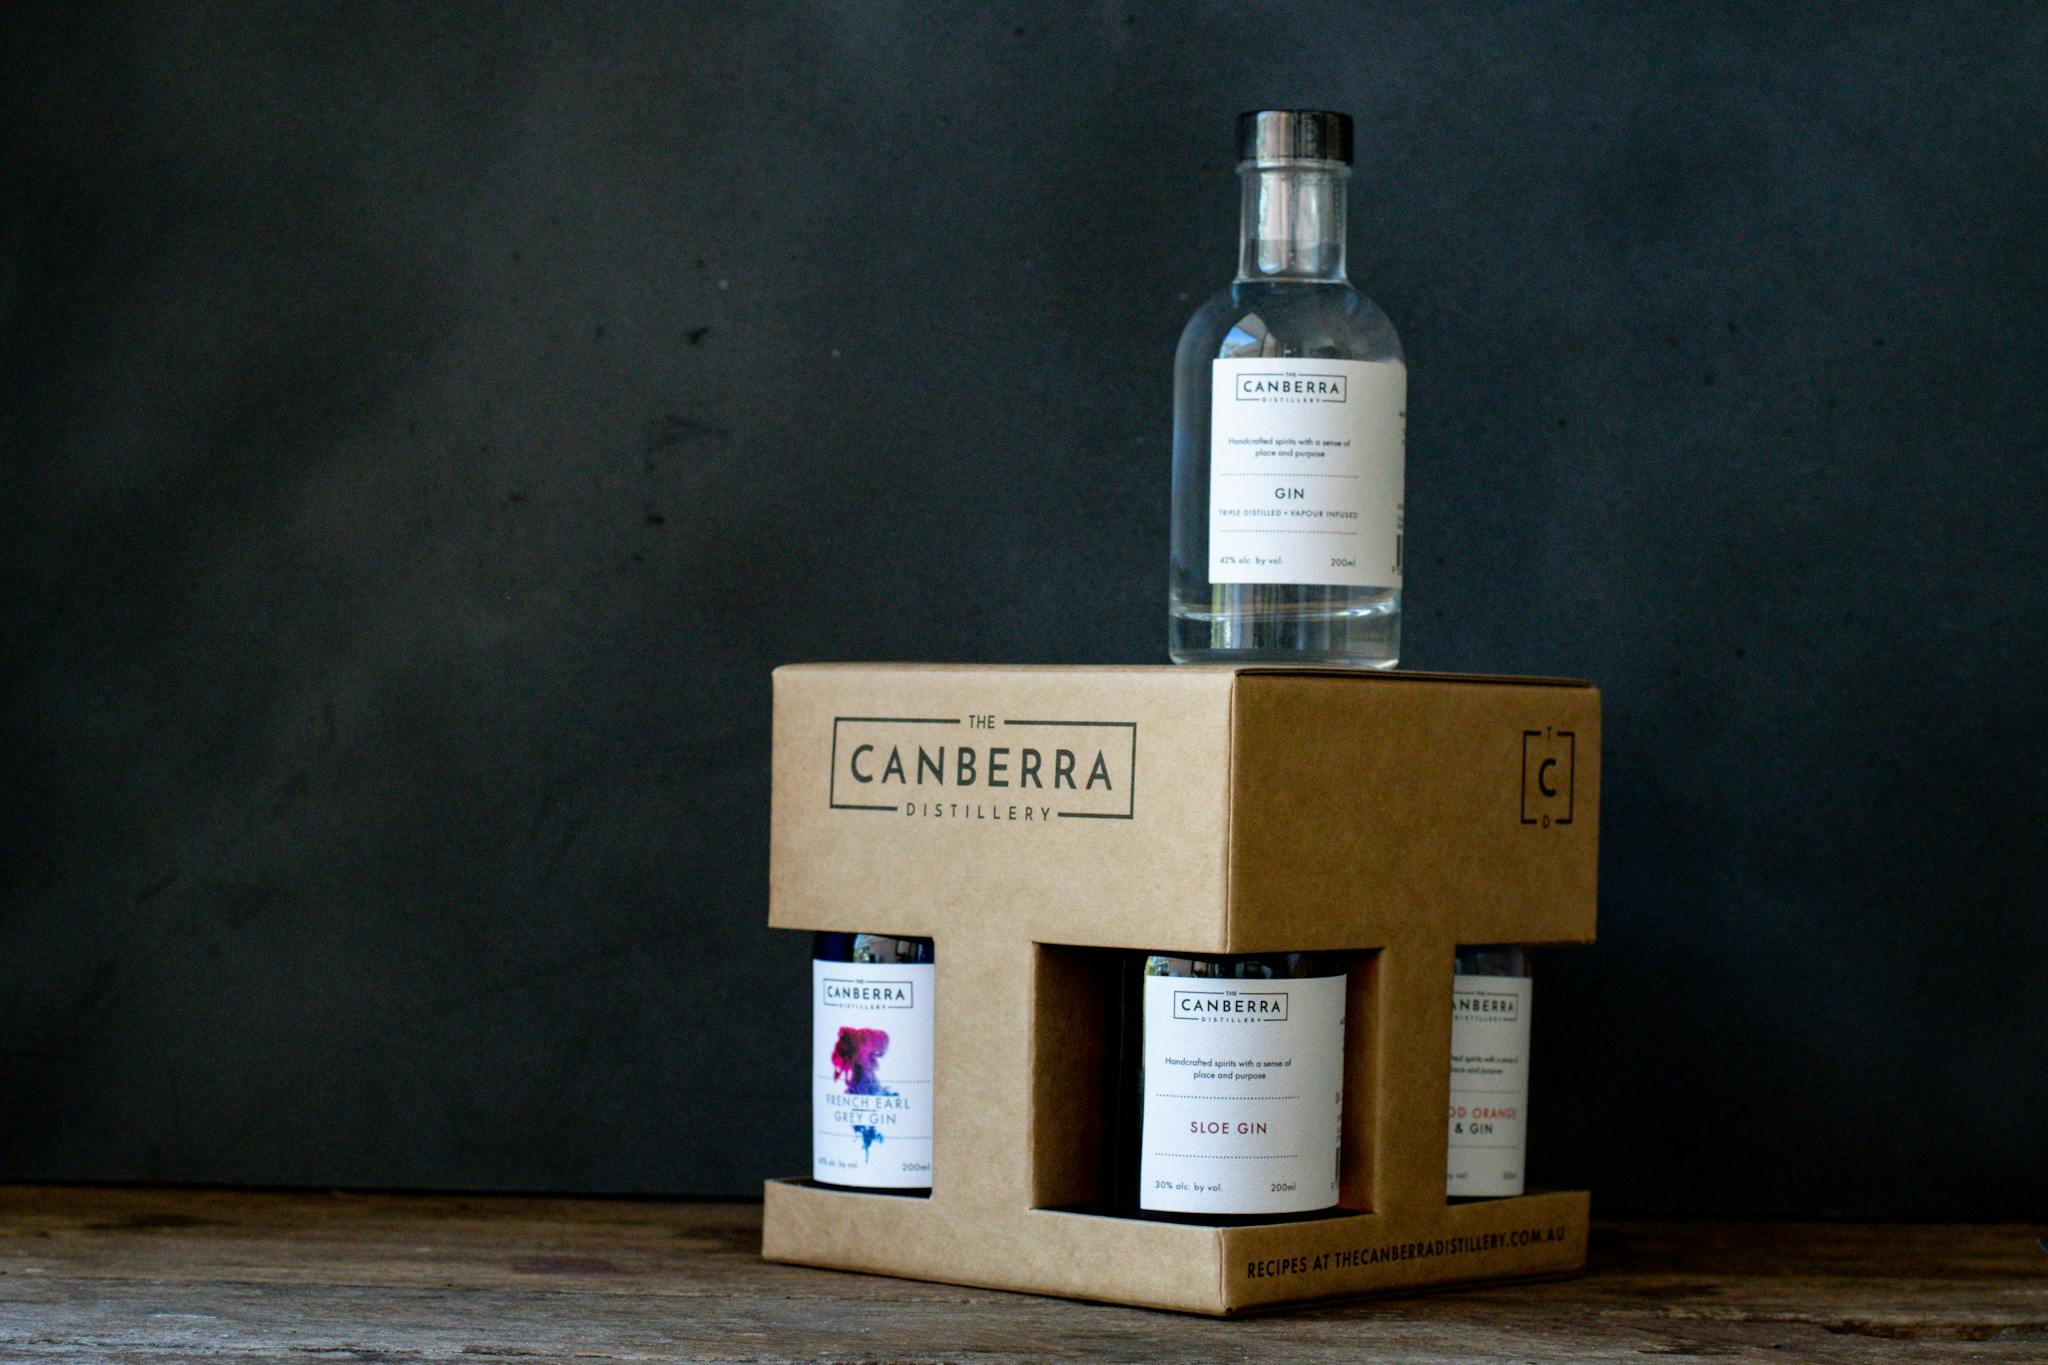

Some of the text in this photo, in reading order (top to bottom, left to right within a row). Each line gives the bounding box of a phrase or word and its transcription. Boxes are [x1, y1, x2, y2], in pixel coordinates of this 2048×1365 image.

[1243, 380, 1340, 394] CANBERRA
[1229, 438, 1273, 446] Handcrafted
[1275, 438, 1296, 447] spirits
[1298, 438, 1314, 446] with
[1343, 439, 1351, 447] of
[1255, 449, 1325, 459] place and purpose
[1275, 487, 1304, 500] GIN
[1243, 509, 1282, 517] DISTILLED
[1290, 510, 1323, 518] VAPOUR
[1326, 511, 1358, 519] INFUSED
[1220, 556, 1236, 564] 42%
[1255, 557, 1265, 566] by
[1268, 557, 1283, 565] vol.
[1330, 558, 1356, 567] 200ml
[968, 714, 996, 729] THE
[1546, 726, 1553, 740] T
[850, 743, 1113, 791] CANBERRA
[1539, 758, 1557, 798] C
[906, 802, 1051, 822] DISTILLERY
[1542, 814, 1551, 829] D
[827, 985, 905, 1001] CANBERRA
[1181, 998, 1281, 1013] CANBERRA
[1165, 1057, 1212, 1067] Handcrafted
[1214, 1058, 1236, 1069] spirits
[1238, 1058, 1254, 1067] with
[1284, 1058, 1292, 1067] of
[1193, 1071, 1266, 1081] place and purpose
[826, 1094, 911, 1110] FRENCH EARL
[834, 1110, 896, 1125] GREY GIN
[1473, 1106, 1517, 1119] ORANGE
[1191, 1121, 1267, 1136] SLOE GIN
[1455, 1123, 1493, 1134] & GIN
[902, 1163, 930, 1171] 200ml
[1155, 1180, 1296, 1192] 30% alc. by vol. 200ml
[1247, 1226, 1565, 1279] RECIPES AT THECANBERRADISTILLERY.COM.AU
